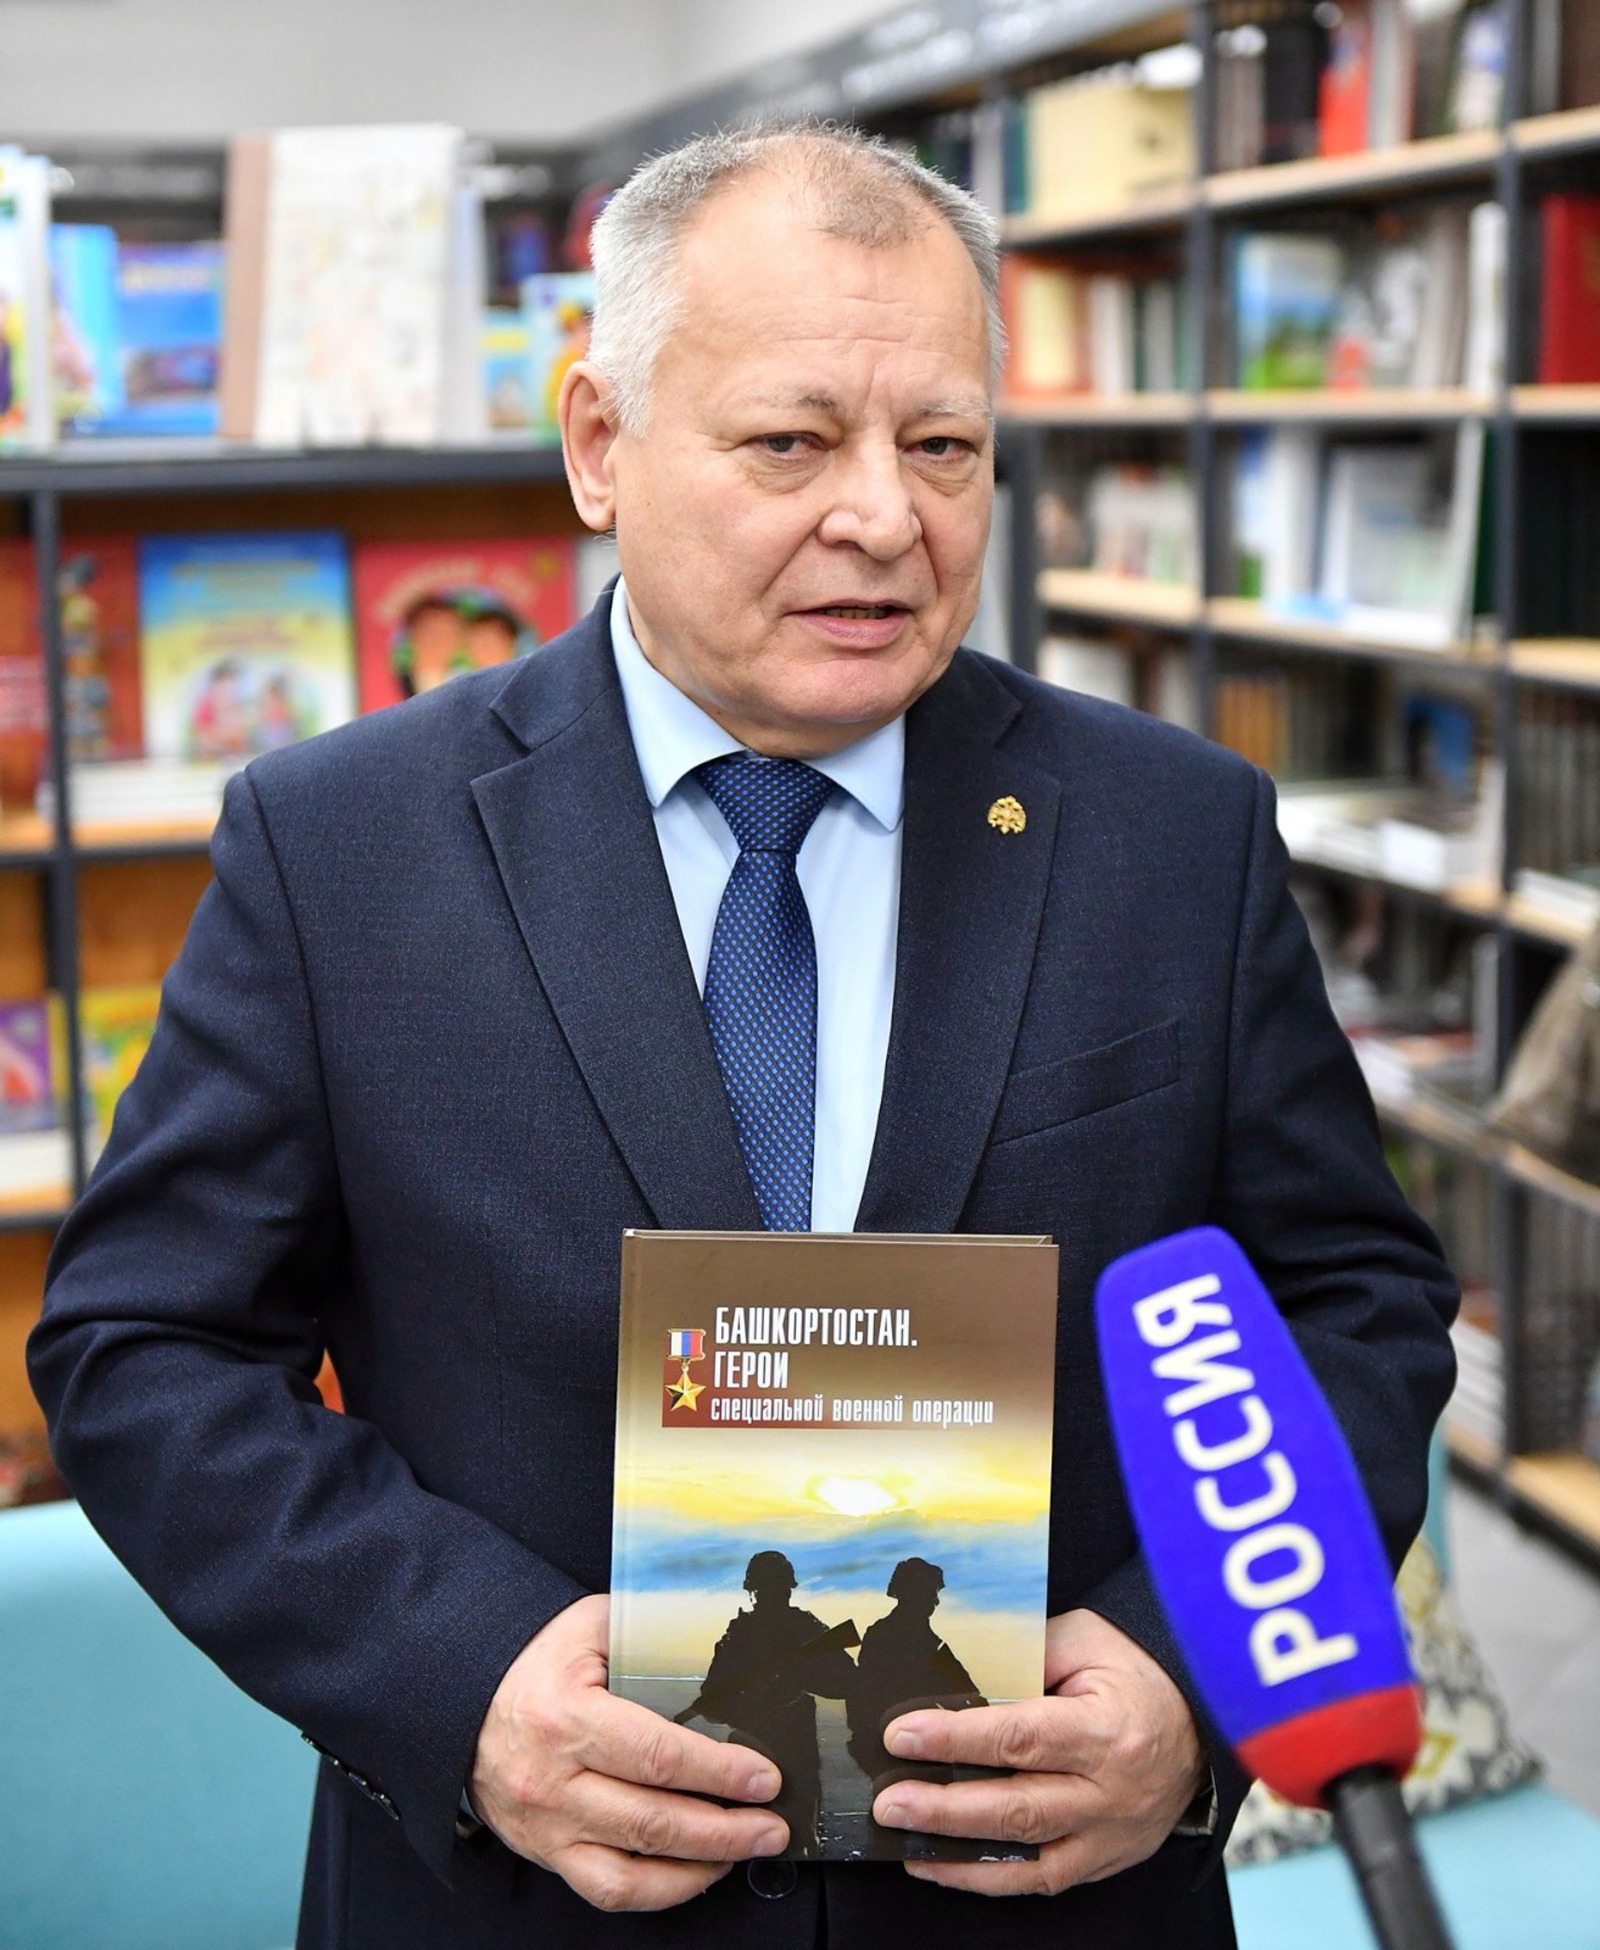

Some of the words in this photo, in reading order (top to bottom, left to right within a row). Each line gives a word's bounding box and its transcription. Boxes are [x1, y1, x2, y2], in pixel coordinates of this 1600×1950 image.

[714, 1307, 918, 1346] БАШКОРТОСТАН.
[713, 1351, 788, 1389] ГЕРОИ
[711, 1394, 823, 1424] специальной
[832, 1395, 903, 1423] военной
[912, 1400, 993, 1429] операции
[1132, 1273, 1359, 1687] РОССИЯ
